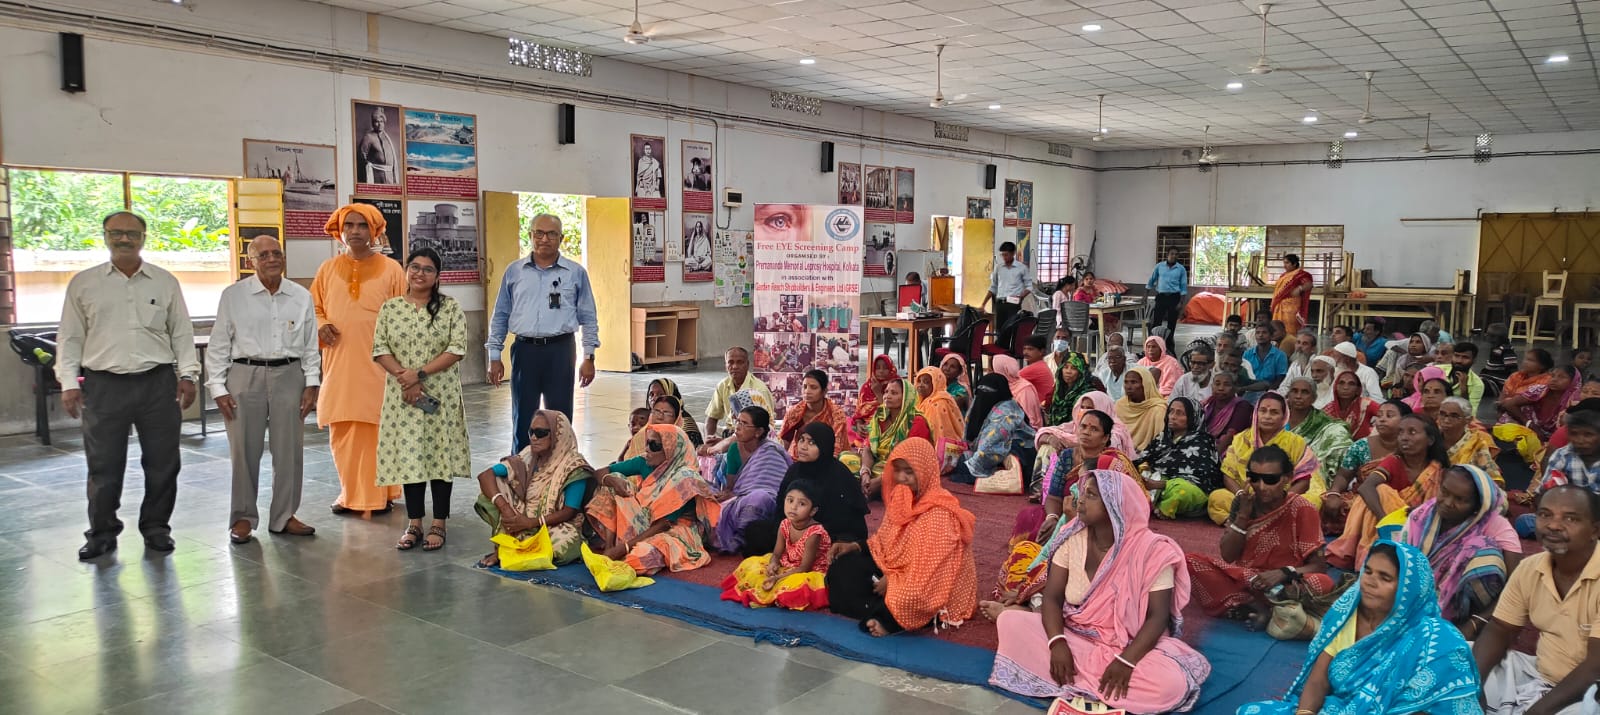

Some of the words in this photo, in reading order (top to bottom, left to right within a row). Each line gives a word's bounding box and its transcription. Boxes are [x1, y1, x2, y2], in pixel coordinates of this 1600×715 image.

[757, 242, 774, 250] Free
[776, 242, 792, 251] EYE
[794, 242, 834, 253] Screening
[835, 244, 859, 254] Camp
[783, 260, 803, 271] Memorial
[804, 261, 822, 273] Leprosy
[842, 262, 860, 272] Kolkata
[755, 282, 770, 291] Garden
[770, 282, 784, 291] Reach
[784, 283, 810, 293] Shipbuilders
[815, 283, 835, 294] Engineers
